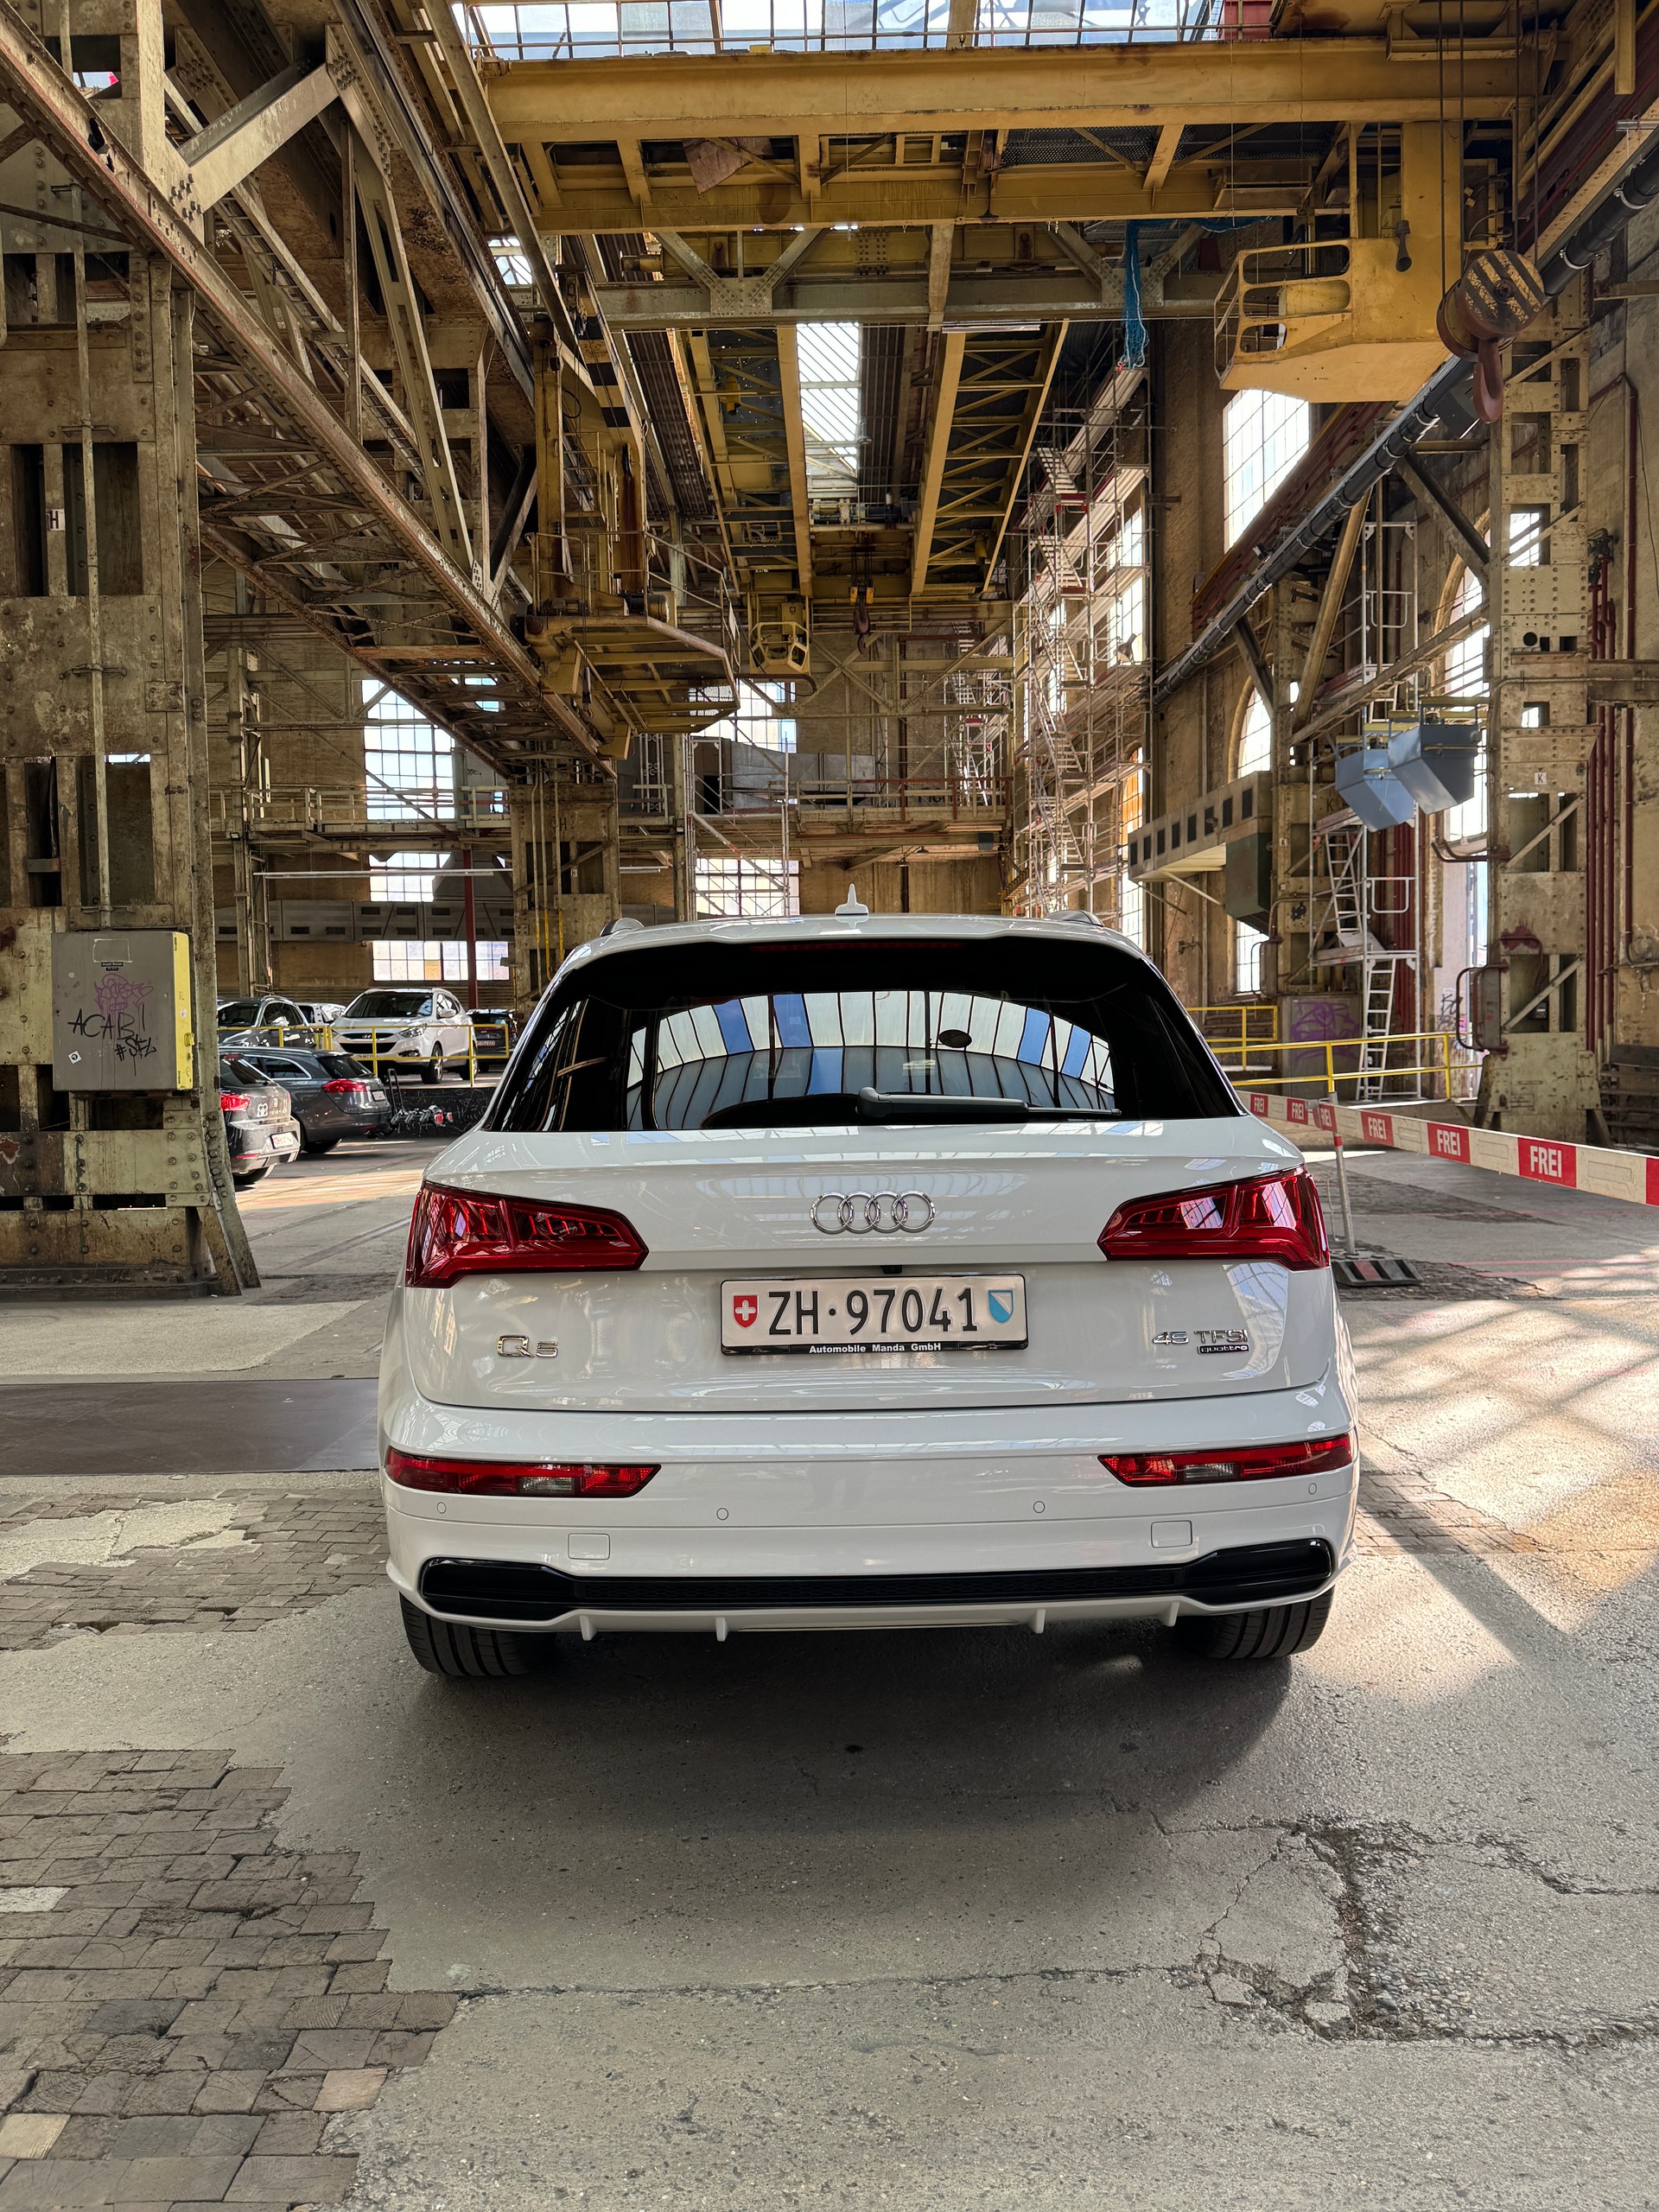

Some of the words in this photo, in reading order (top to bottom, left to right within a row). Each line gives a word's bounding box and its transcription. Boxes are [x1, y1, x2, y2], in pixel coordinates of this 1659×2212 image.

[49, 511, 59, 529] H
[1538, 773, 1543, 783] K
[560, 817, 567, 830] H
[1254, 1096, 1264, 1113] FREI
[1291, 1102, 1304, 1120] FREI
[1368, 1117, 1387, 1140] FREI
[1437, 1129, 1461, 1156] FREI
[1529, 1145, 1562, 1178] FREI
[1153, 1331, 1189, 1344] 45
[1193, 1329, 1249, 1344] TFSI
[497, 1335, 559, 1358] Q5
[809, 1344, 867, 1355] Automobile
[872, 1344, 906, 1353] Manda
[911, 1342, 942, 1352] GmbH
